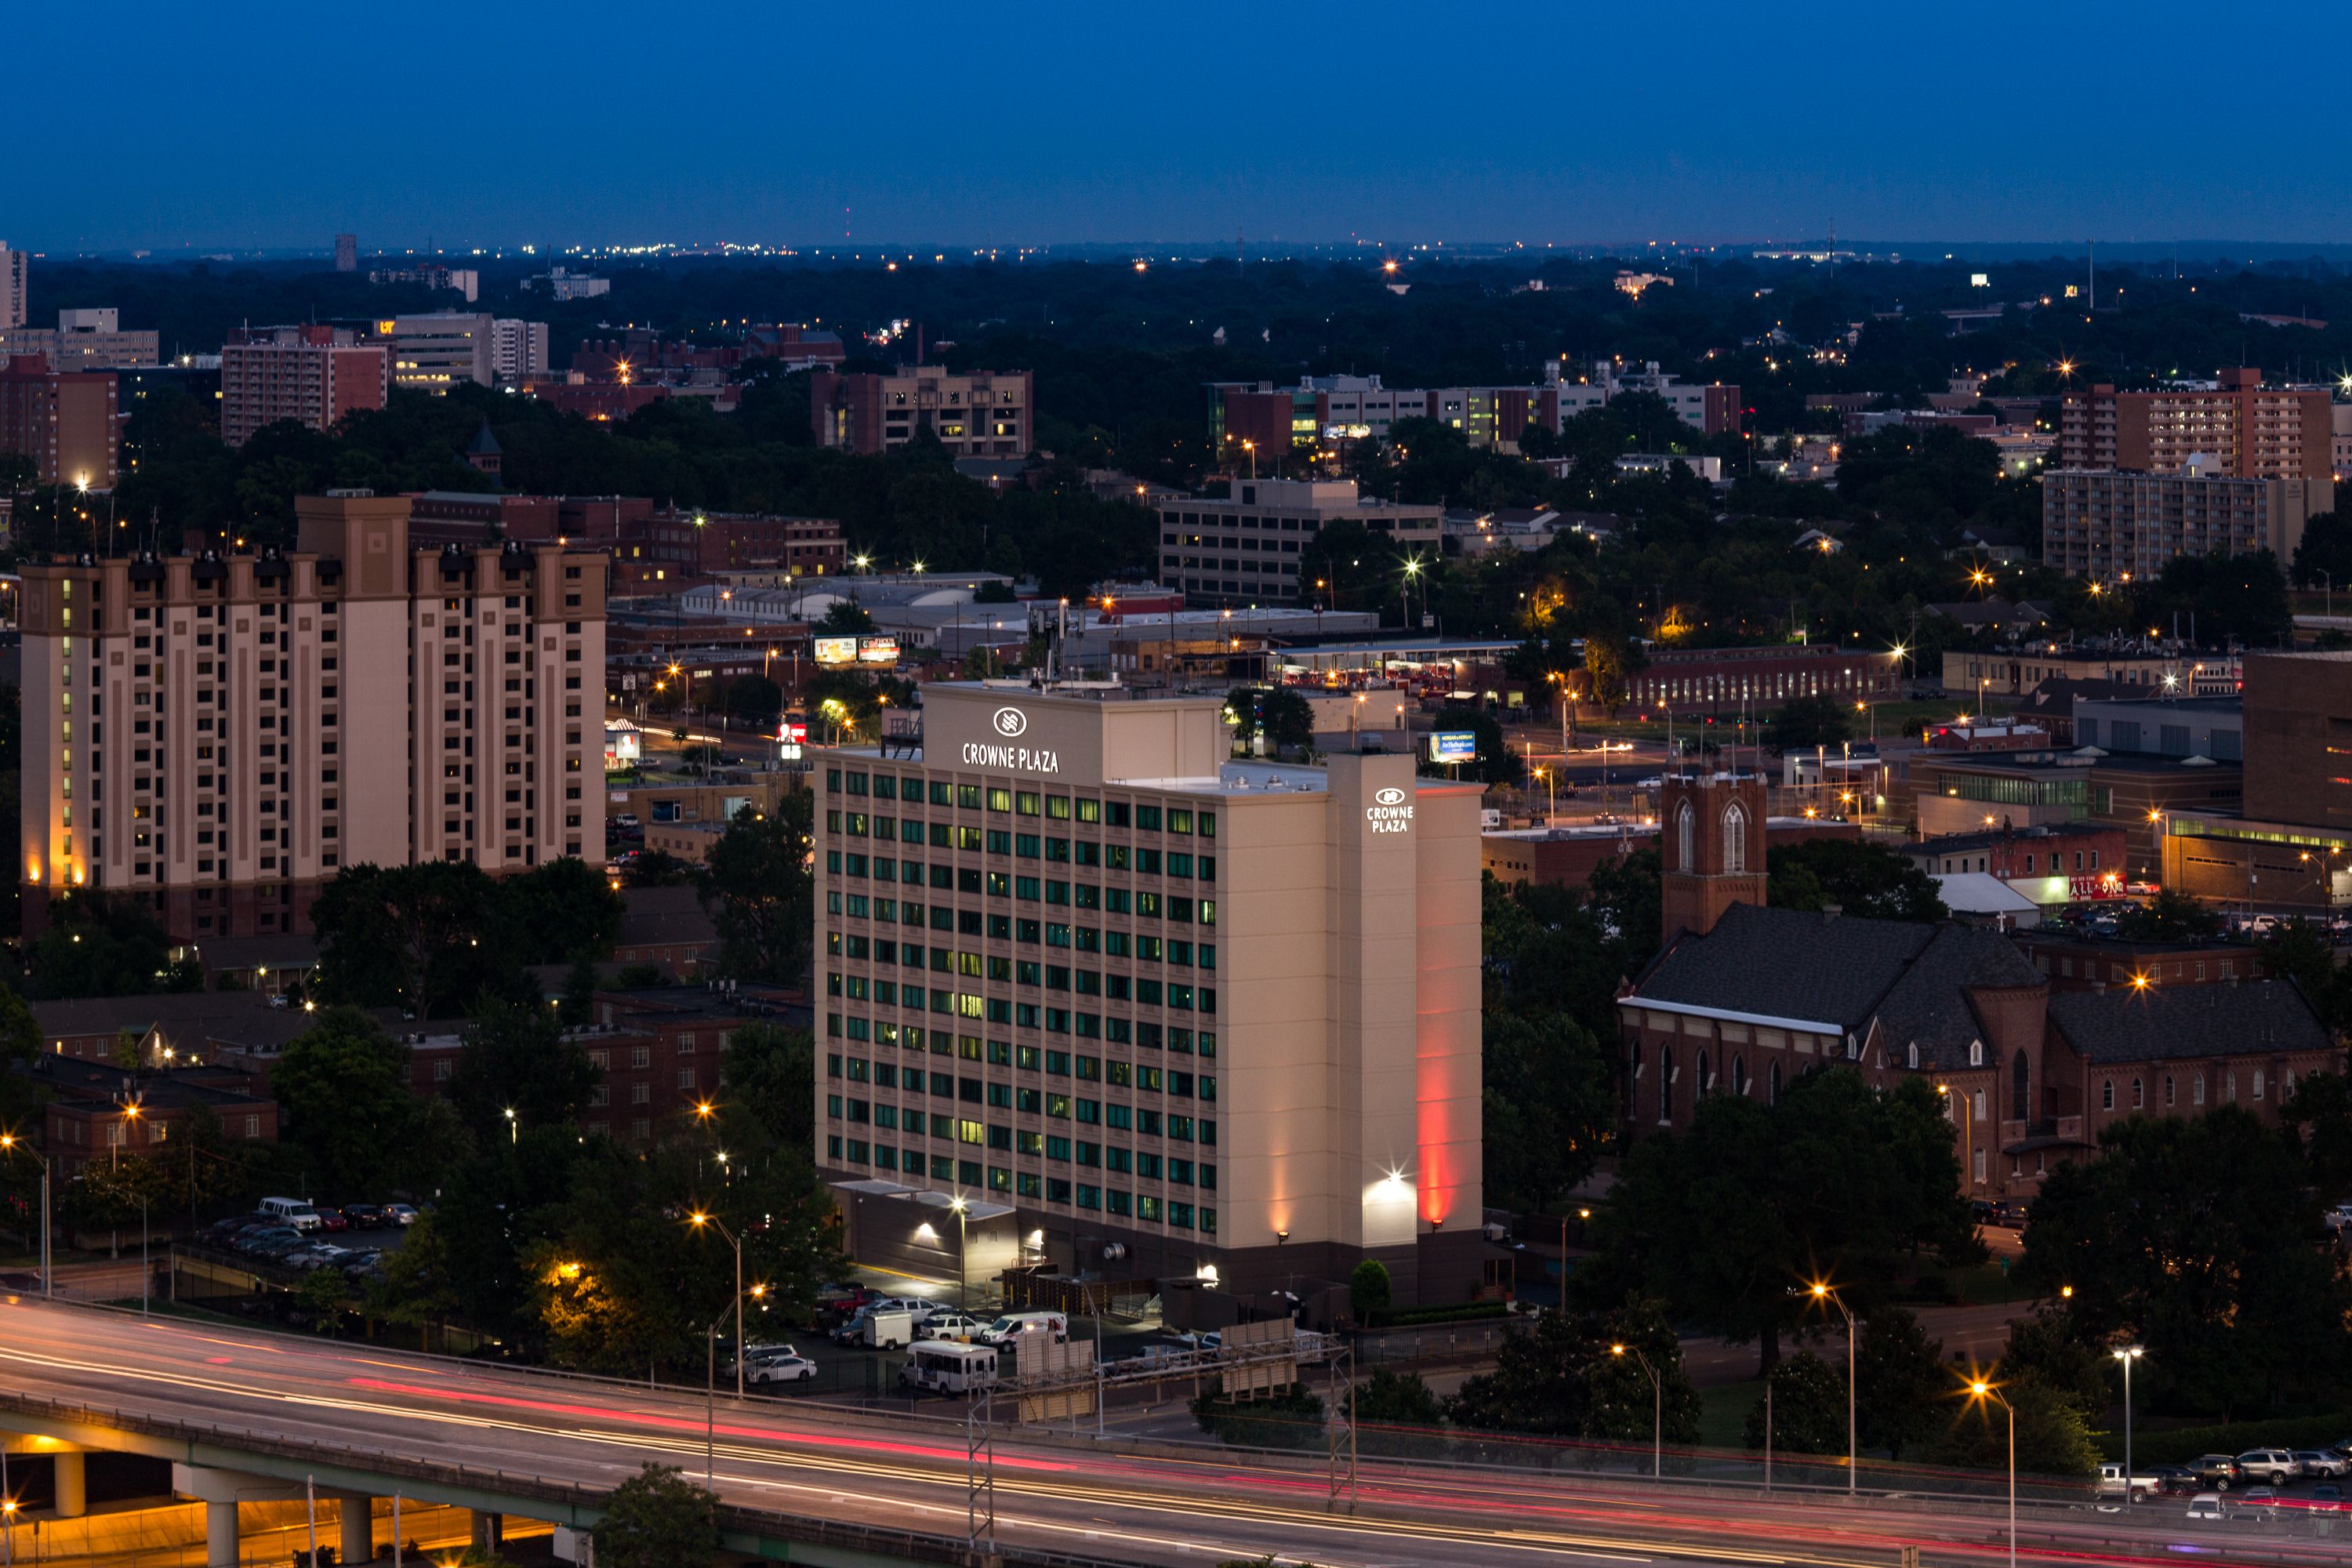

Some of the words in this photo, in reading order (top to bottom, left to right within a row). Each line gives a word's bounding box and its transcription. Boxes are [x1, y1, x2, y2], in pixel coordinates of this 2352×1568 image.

[379, 321, 395, 334] UT
[963, 742, 1015, 768] CROWNE
[1019, 748, 1059, 773] PLAZA
[1367, 805, 1414, 821] CROWNE
[1372, 819, 1407, 833] PLAZA
